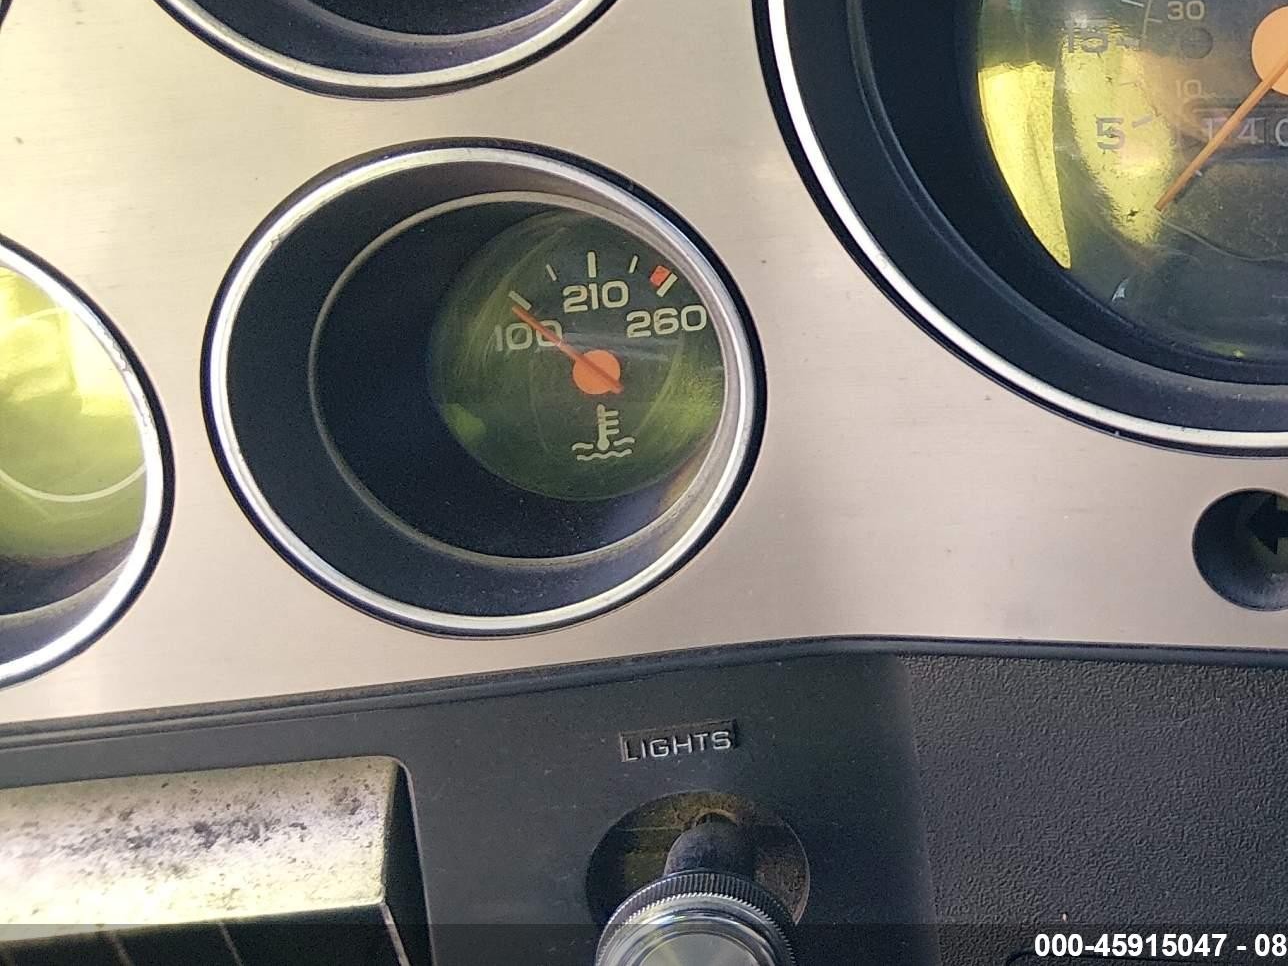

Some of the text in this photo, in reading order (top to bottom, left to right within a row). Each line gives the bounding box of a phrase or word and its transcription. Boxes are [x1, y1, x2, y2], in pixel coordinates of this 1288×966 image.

[1166, 0, 1206, 22] 30
[1174, 78, 1202, 99] 10
[1095, 116, 1126, 150] 5
[562, 280, 630, 313] 210
[494, 319, 564, 352] 100
[626, 304, 708, 339] 260
[623, 731, 732, 762] LIGHTS
